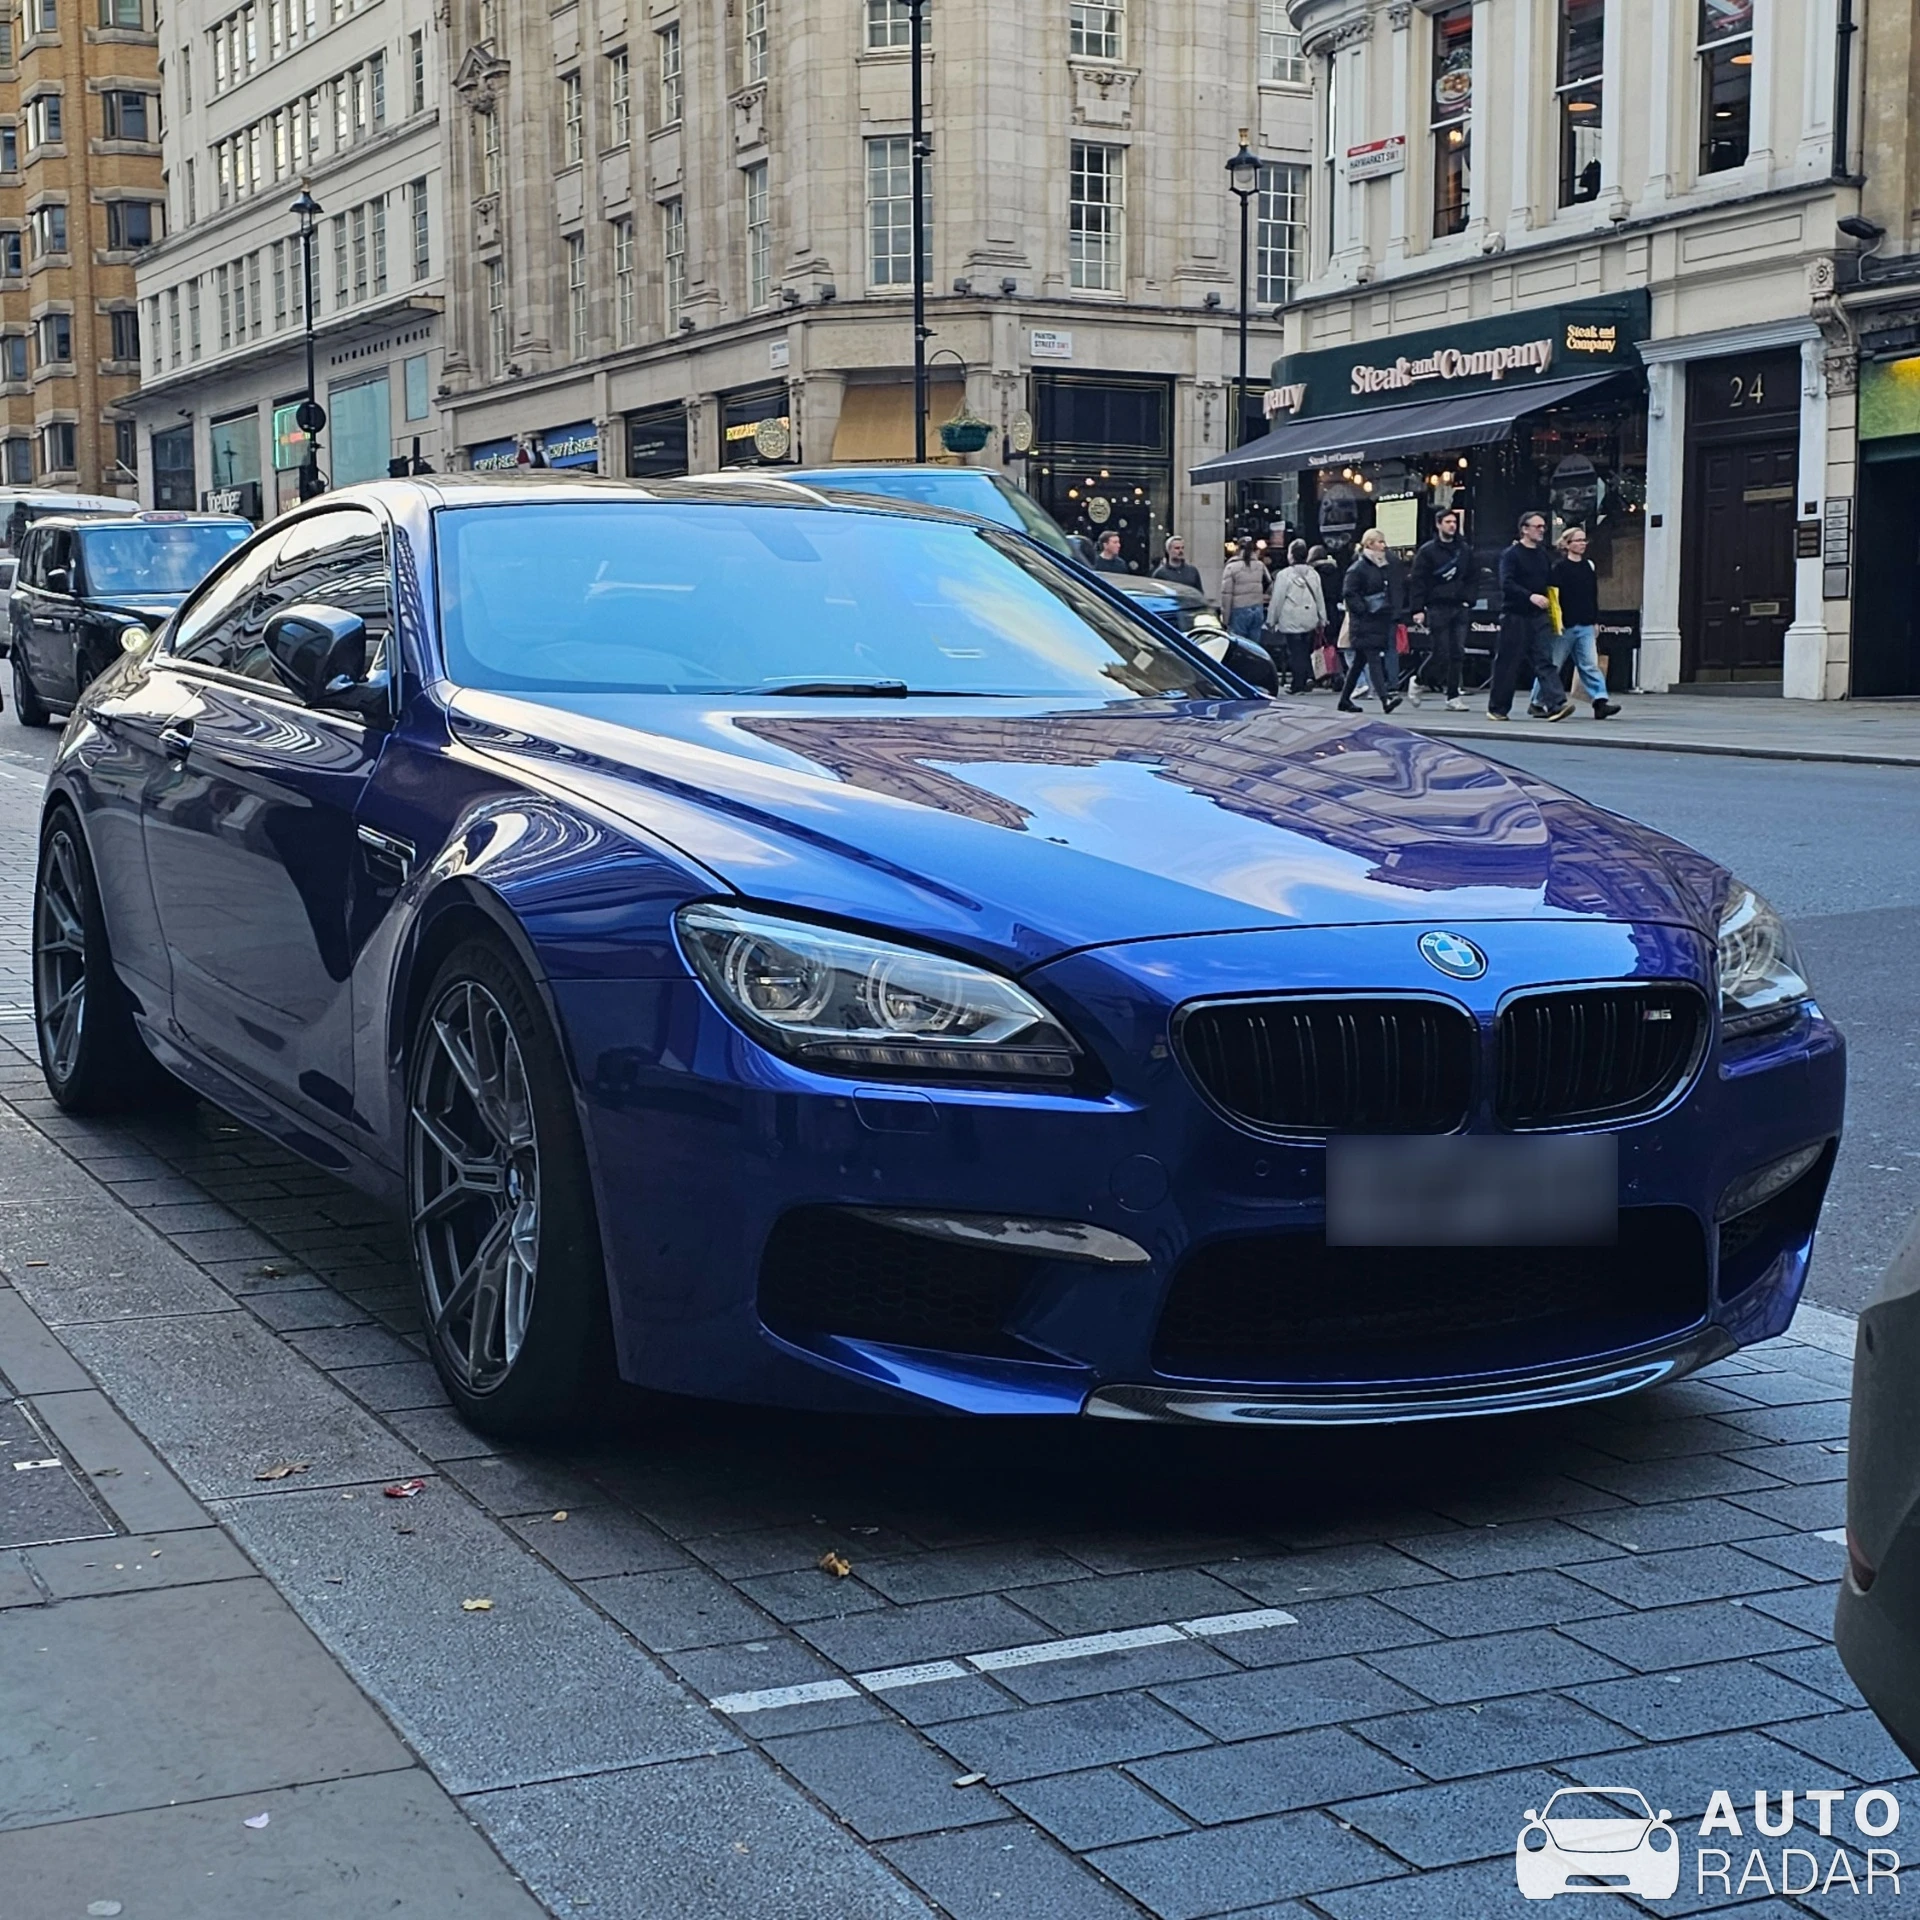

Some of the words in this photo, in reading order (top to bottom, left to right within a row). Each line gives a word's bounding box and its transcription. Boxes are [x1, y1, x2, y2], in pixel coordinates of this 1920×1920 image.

[1350, 152, 1385, 168] HAYMARKET
[1034, 332, 1057, 340] PANTON
[1567, 324, 1598, 338] Steak
[331, 339, 390, 365] HAYMARKET
[1034, 340, 1055, 348] STREET
[1566, 336, 1616, 353] Company
[1351, 356, 1412, 395] Steak
[1410, 350, 1442, 380] and
[1440, 338, 1552, 381] Company
[1729, 372, 1764, 408] 24
[1600, 624, 1632, 636] Company
